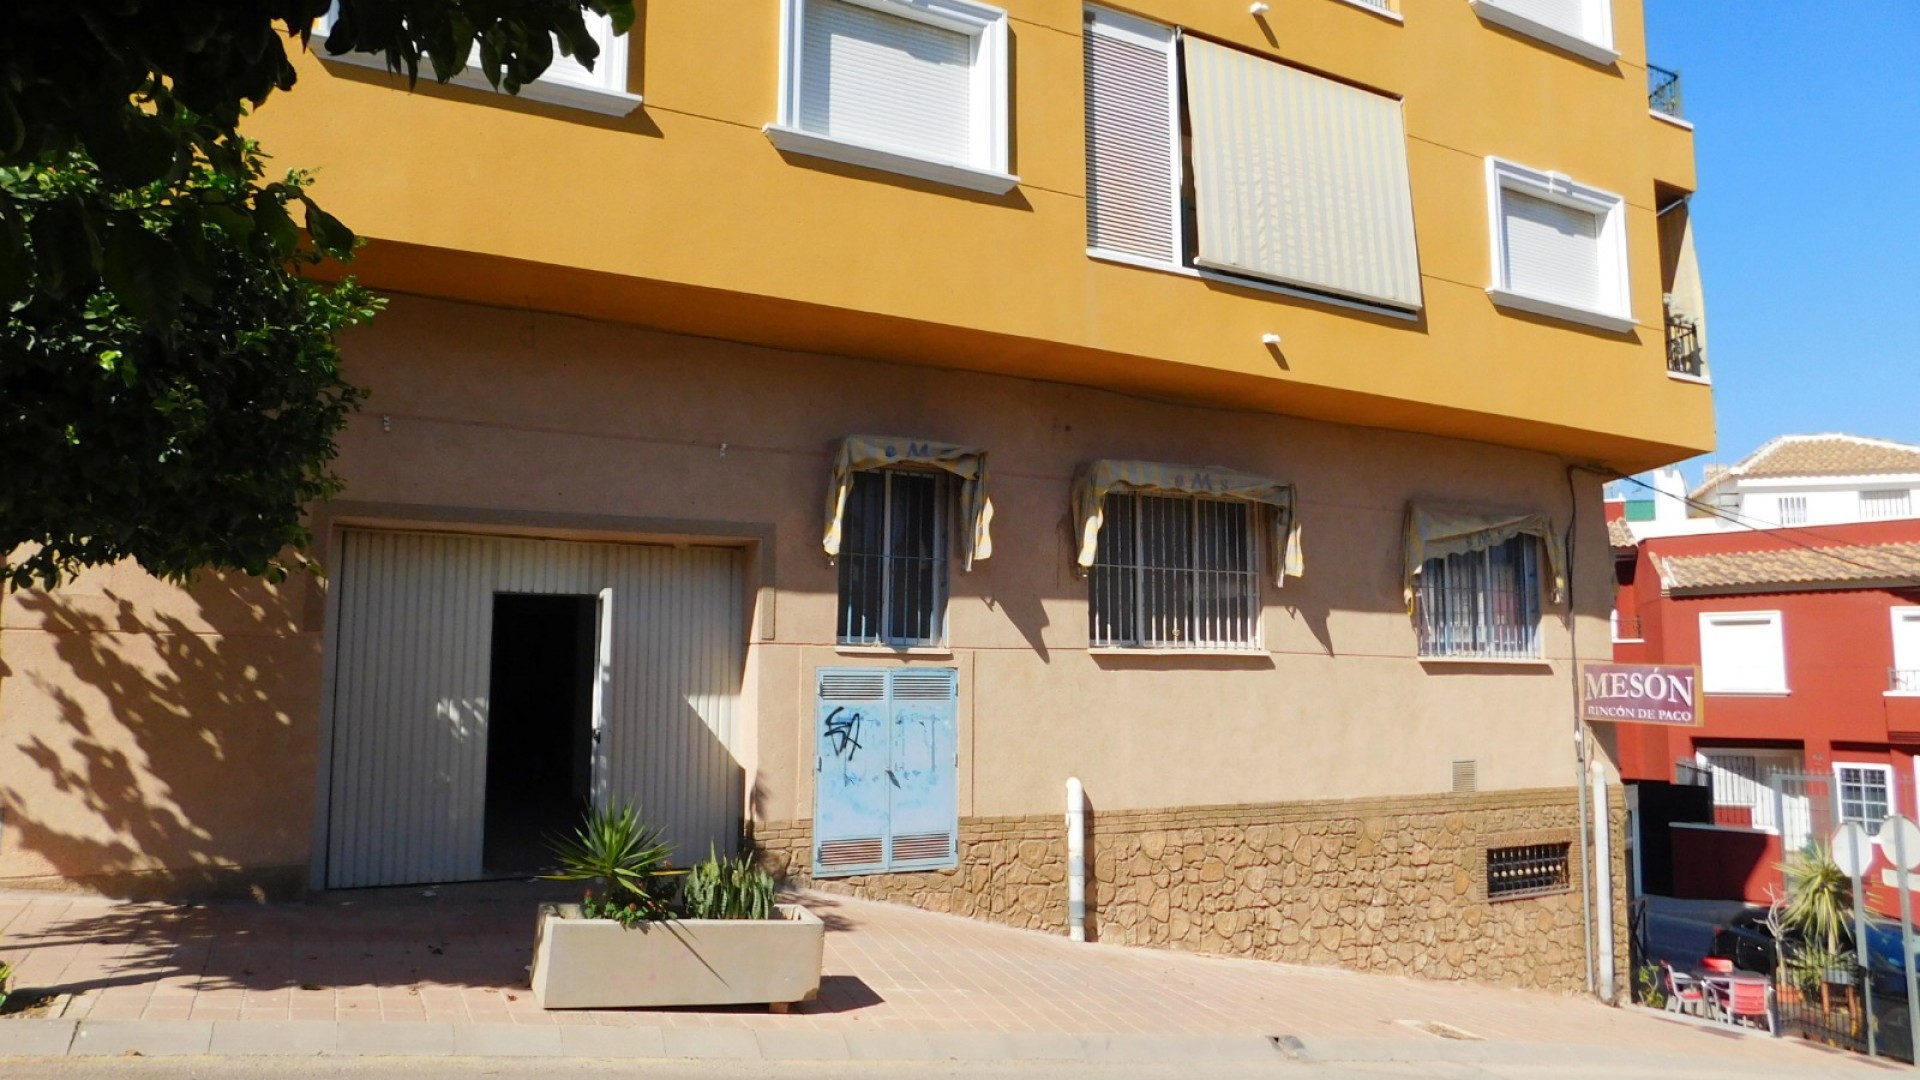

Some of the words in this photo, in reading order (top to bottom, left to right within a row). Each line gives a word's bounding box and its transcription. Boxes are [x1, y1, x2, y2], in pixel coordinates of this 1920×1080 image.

[1584, 667, 1693, 707] MESÓN
[1588, 705, 1635, 718] RINCÓN
[1638, 708, 1656, 720] DE
[1658, 709, 1692, 722] PACO
